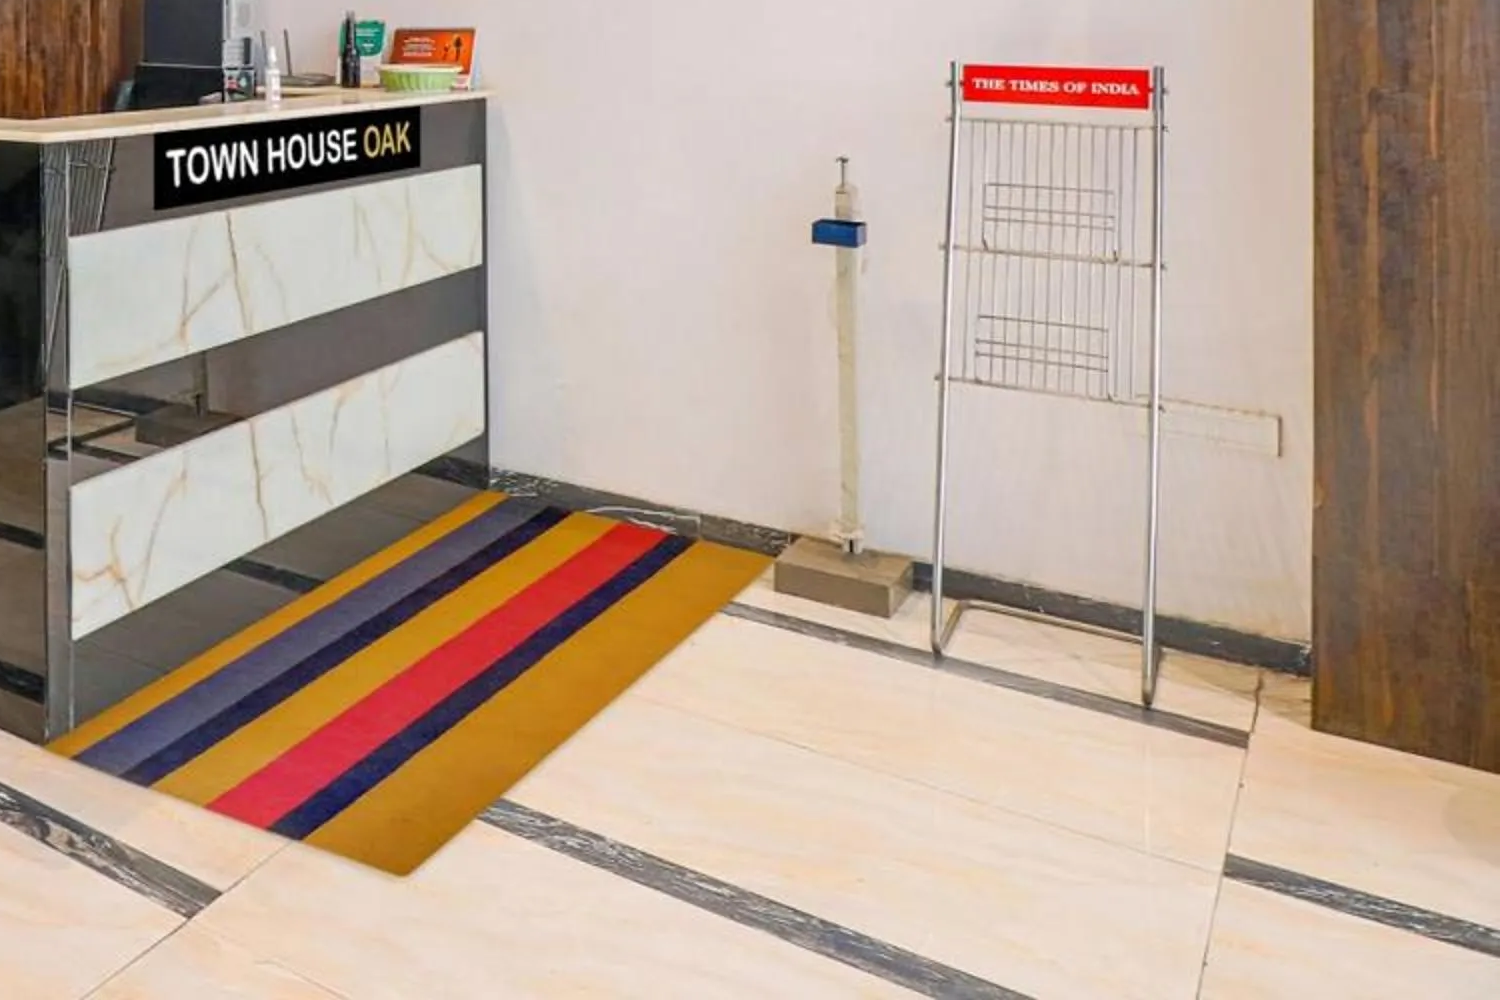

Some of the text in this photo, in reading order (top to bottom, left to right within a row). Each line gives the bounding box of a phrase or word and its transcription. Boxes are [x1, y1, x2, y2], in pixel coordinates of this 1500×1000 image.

[972, 77, 1140, 96] THE TIMES OF INDIA
[166, 121, 412, 188] TOWN HOUSE OAK
